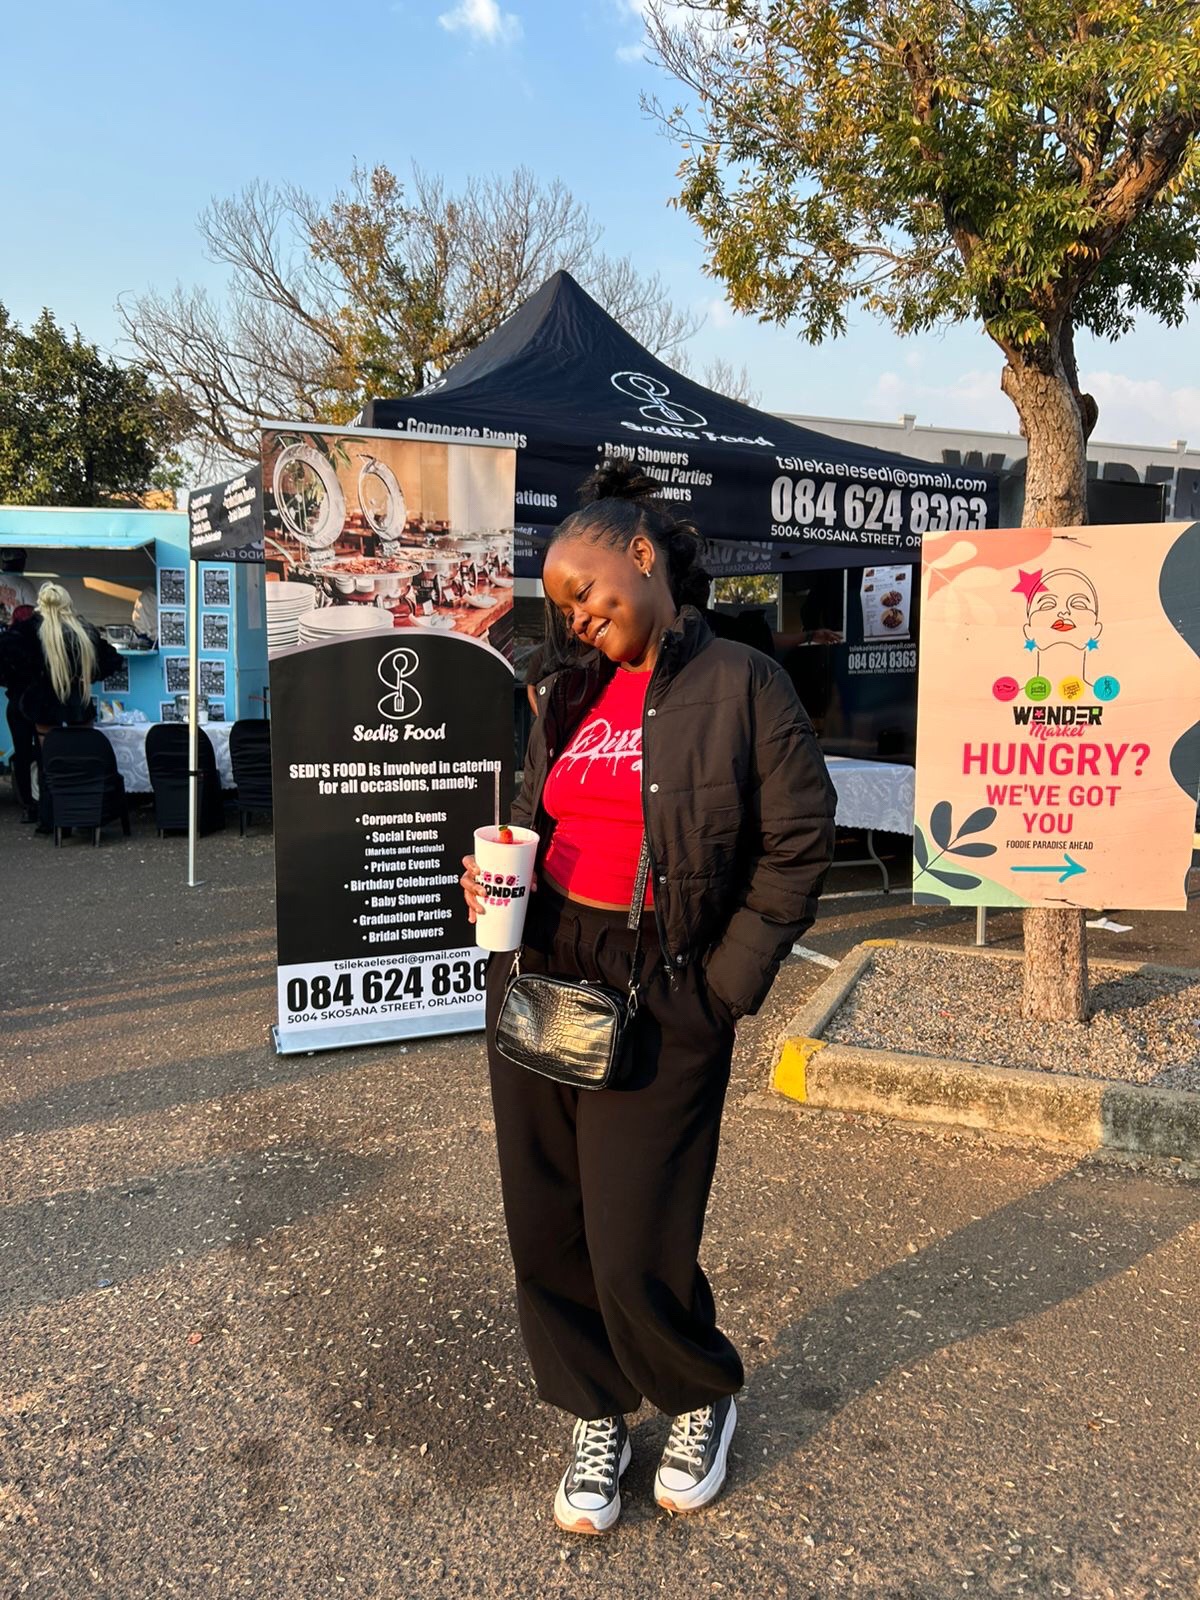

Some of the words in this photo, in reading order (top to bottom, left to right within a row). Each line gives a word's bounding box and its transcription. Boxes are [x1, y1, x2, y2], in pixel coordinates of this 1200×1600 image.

[701, 431, 776, 447] Food
[604, 442, 636, 462] Baby
[637, 446, 689, 466] Showers
[671, 467, 713, 486] Parties
[775, 454, 988, 493] tsilekaelesedi@gmail.com
[770, 475, 837, 526] 084
[844, 483, 902, 532] 624
[909, 490, 988, 534] 8363
[770, 525, 800, 538] 5004
[802, 527, 859, 543] SKOSANA
[860, 532, 903, 548] STREET,
[848, 653, 867, 670] 084
[868, 651, 887, 669] 624
[889, 650, 917, 668] 8363
[1013, 705, 1103, 726] WONDER
[352, 723, 399, 743] Sedi's
[403, 722, 447, 741] Food
[1029, 720, 1089, 741] Market
[289, 762, 331, 779] SEDI'S
[333, 761, 367, 778] FOOD
[369, 762, 381, 777] is
[383, 761, 437, 777] involved
[439, 760, 451, 774] in
[452, 759, 502, 774] catering
[962, 742, 1151, 777] HUNGRY?
[319, 779, 338, 795] for
[341, 778, 358, 794] all
[360, 777, 430, 793] occasions,
[431, 775, 478, 791] namely:
[986, 784, 1061, 807] WE'VE
[1068, 785, 1122, 807] GOT
[362, 812, 414, 827] Corporate
[415, 811, 447, 824] Events
[1023, 812, 1074, 835] YOU
[372, 830, 404, 843] Social
[406, 828, 438, 842] Events
[1006, 839, 1031, 850] FOODIE
[1032, 840, 1067, 850] PARADISE
[1068, 840, 1094, 850] AHEAD
[365, 846, 397, 857] (Markets
[397, 845, 411, 856] and
[412, 843, 445, 855] Festivals)
[371, 860, 407, 873] Private
[408, 858, 440, 871] Events
[350, 878, 395, 892] Birthday
[396, 873, 459, 889] Celebrations
[371, 896, 397, 908] Baby
[398, 893, 441, 906] Showers
[359, 911, 416, 926] Graduation
[418, 909, 452, 922] Parties
[369, 930, 400, 943] Bridal
[401, 927, 444, 940] Showers
[334, 949, 471, 971] tsilekaelesedi@gmail.com
[286, 974, 354, 1013] 084
[362, 966, 424, 1005] 624
[287, 1013, 318, 1024] 5004
[320, 1006, 378, 1021] SKOSANA
[380, 1000, 425, 1014] STREET,
[427, 993, 484, 1007] ORLANDO
